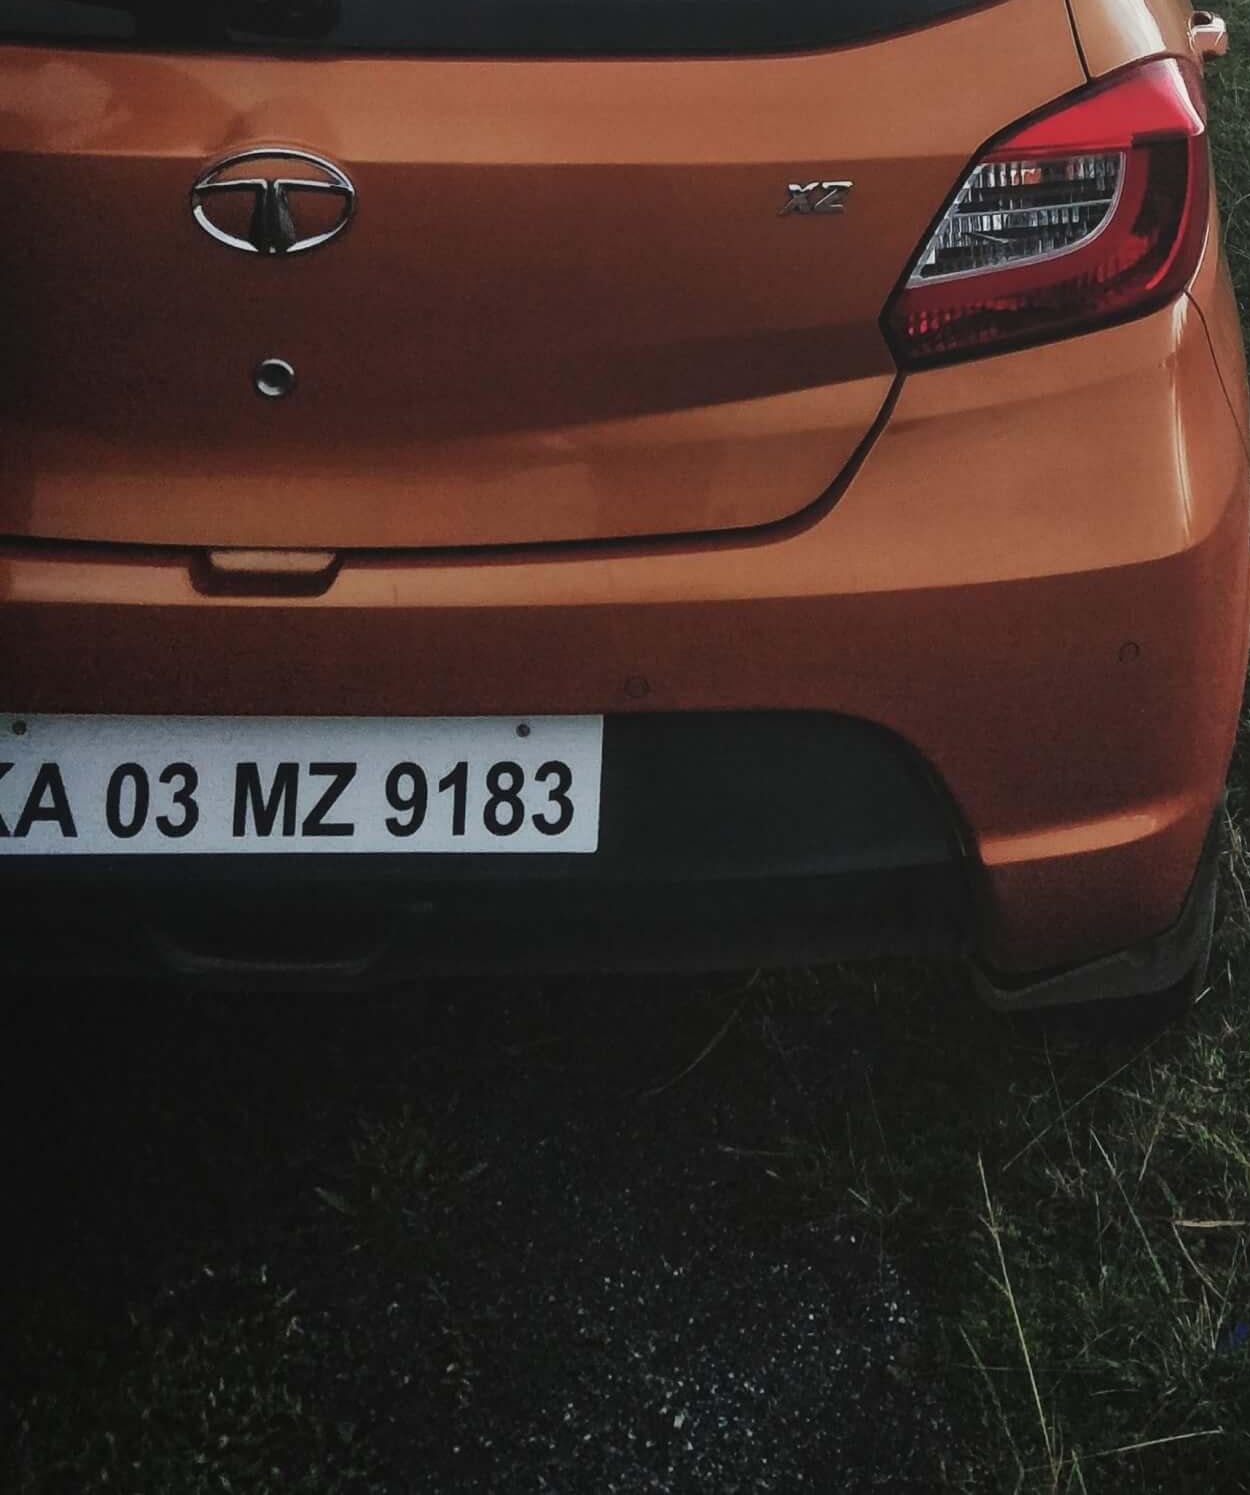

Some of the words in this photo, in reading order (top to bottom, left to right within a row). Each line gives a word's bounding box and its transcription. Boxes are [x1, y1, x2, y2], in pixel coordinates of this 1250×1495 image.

[105, 761, 200, 839] 03
[232, 761, 358, 838] MZ
[384, 760, 575, 838] 9183
